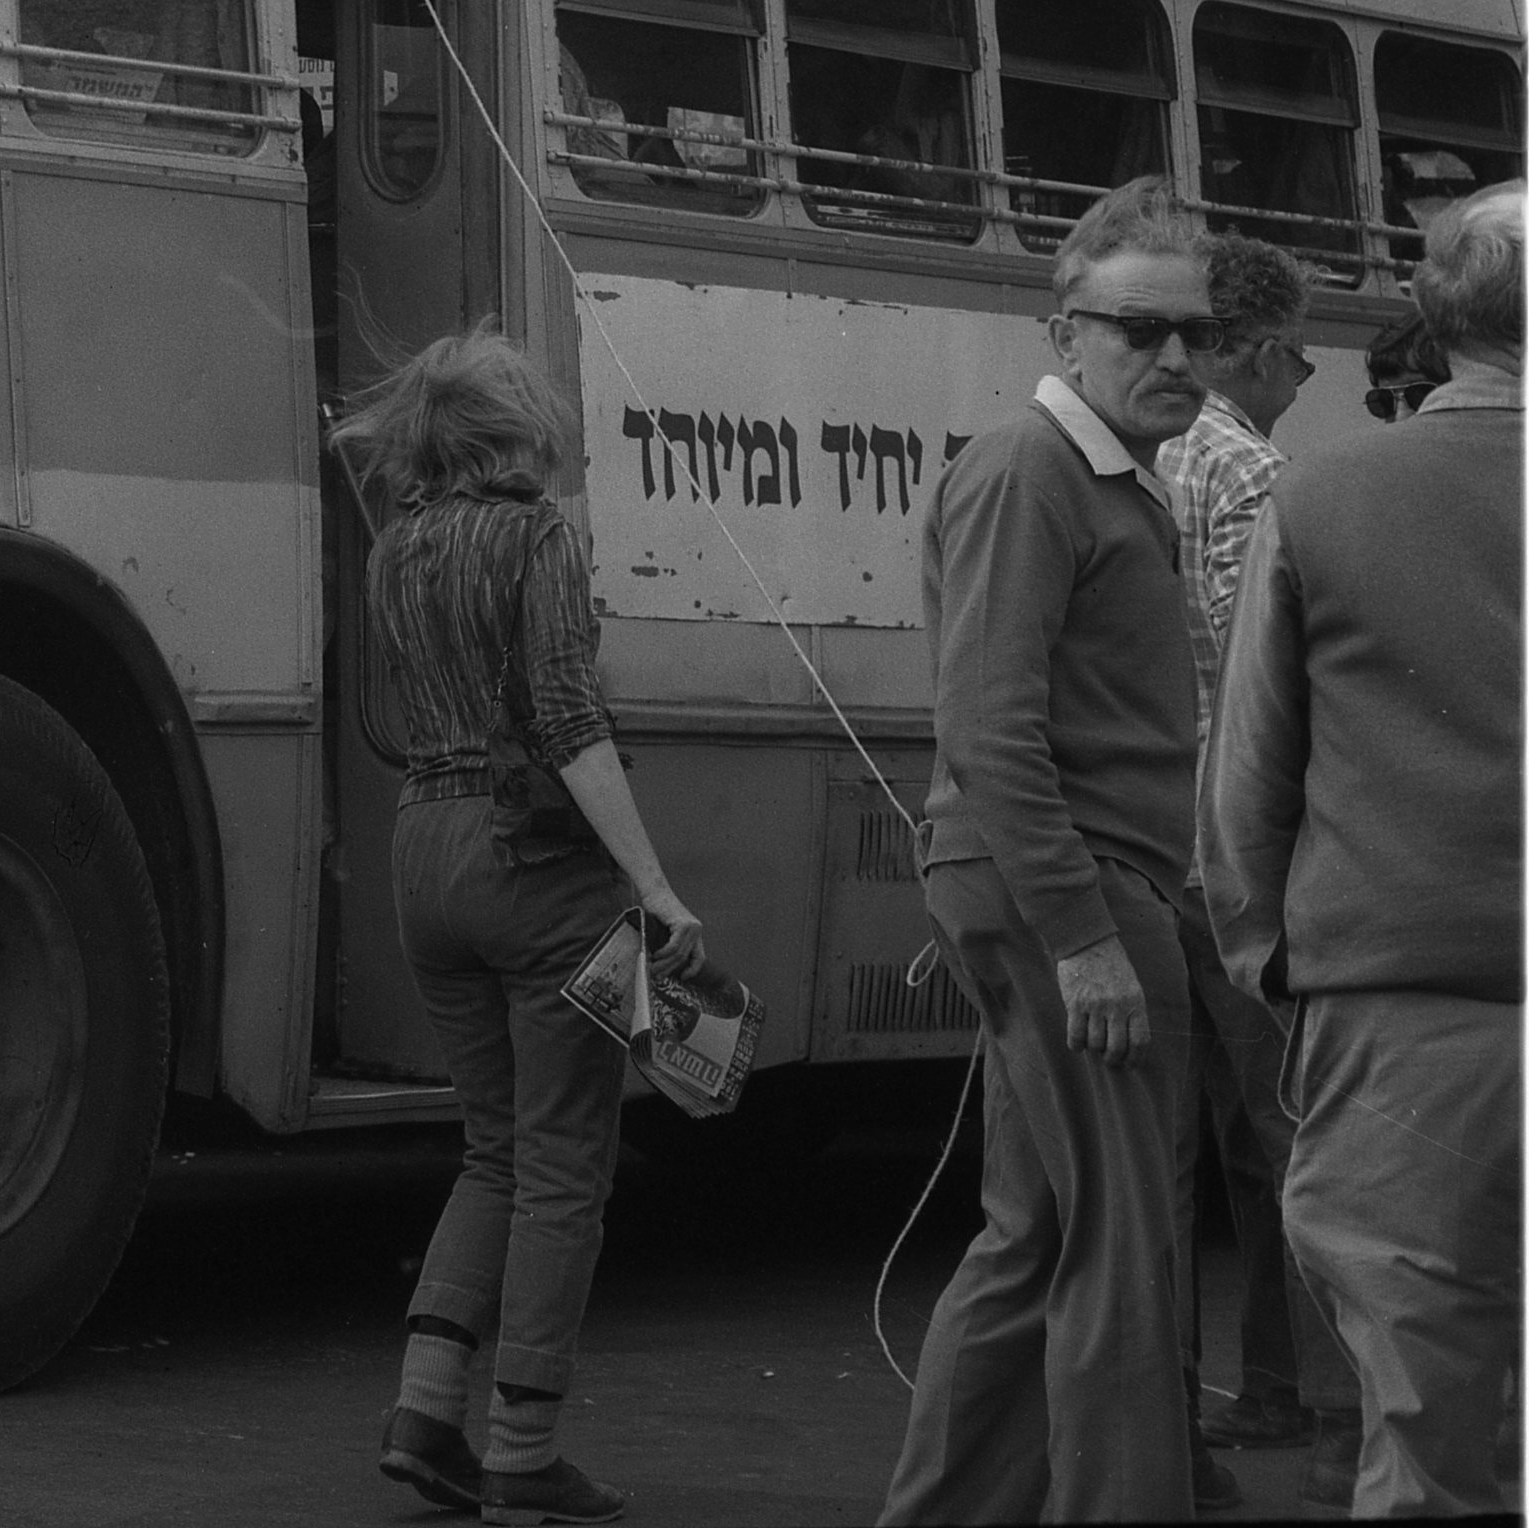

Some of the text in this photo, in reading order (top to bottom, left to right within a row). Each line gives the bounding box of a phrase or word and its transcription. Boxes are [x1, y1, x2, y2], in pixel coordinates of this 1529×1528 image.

[622, 403, 923, 516] יחיד ומיוחד
[659, 1041, 722, 1088] לאשה
